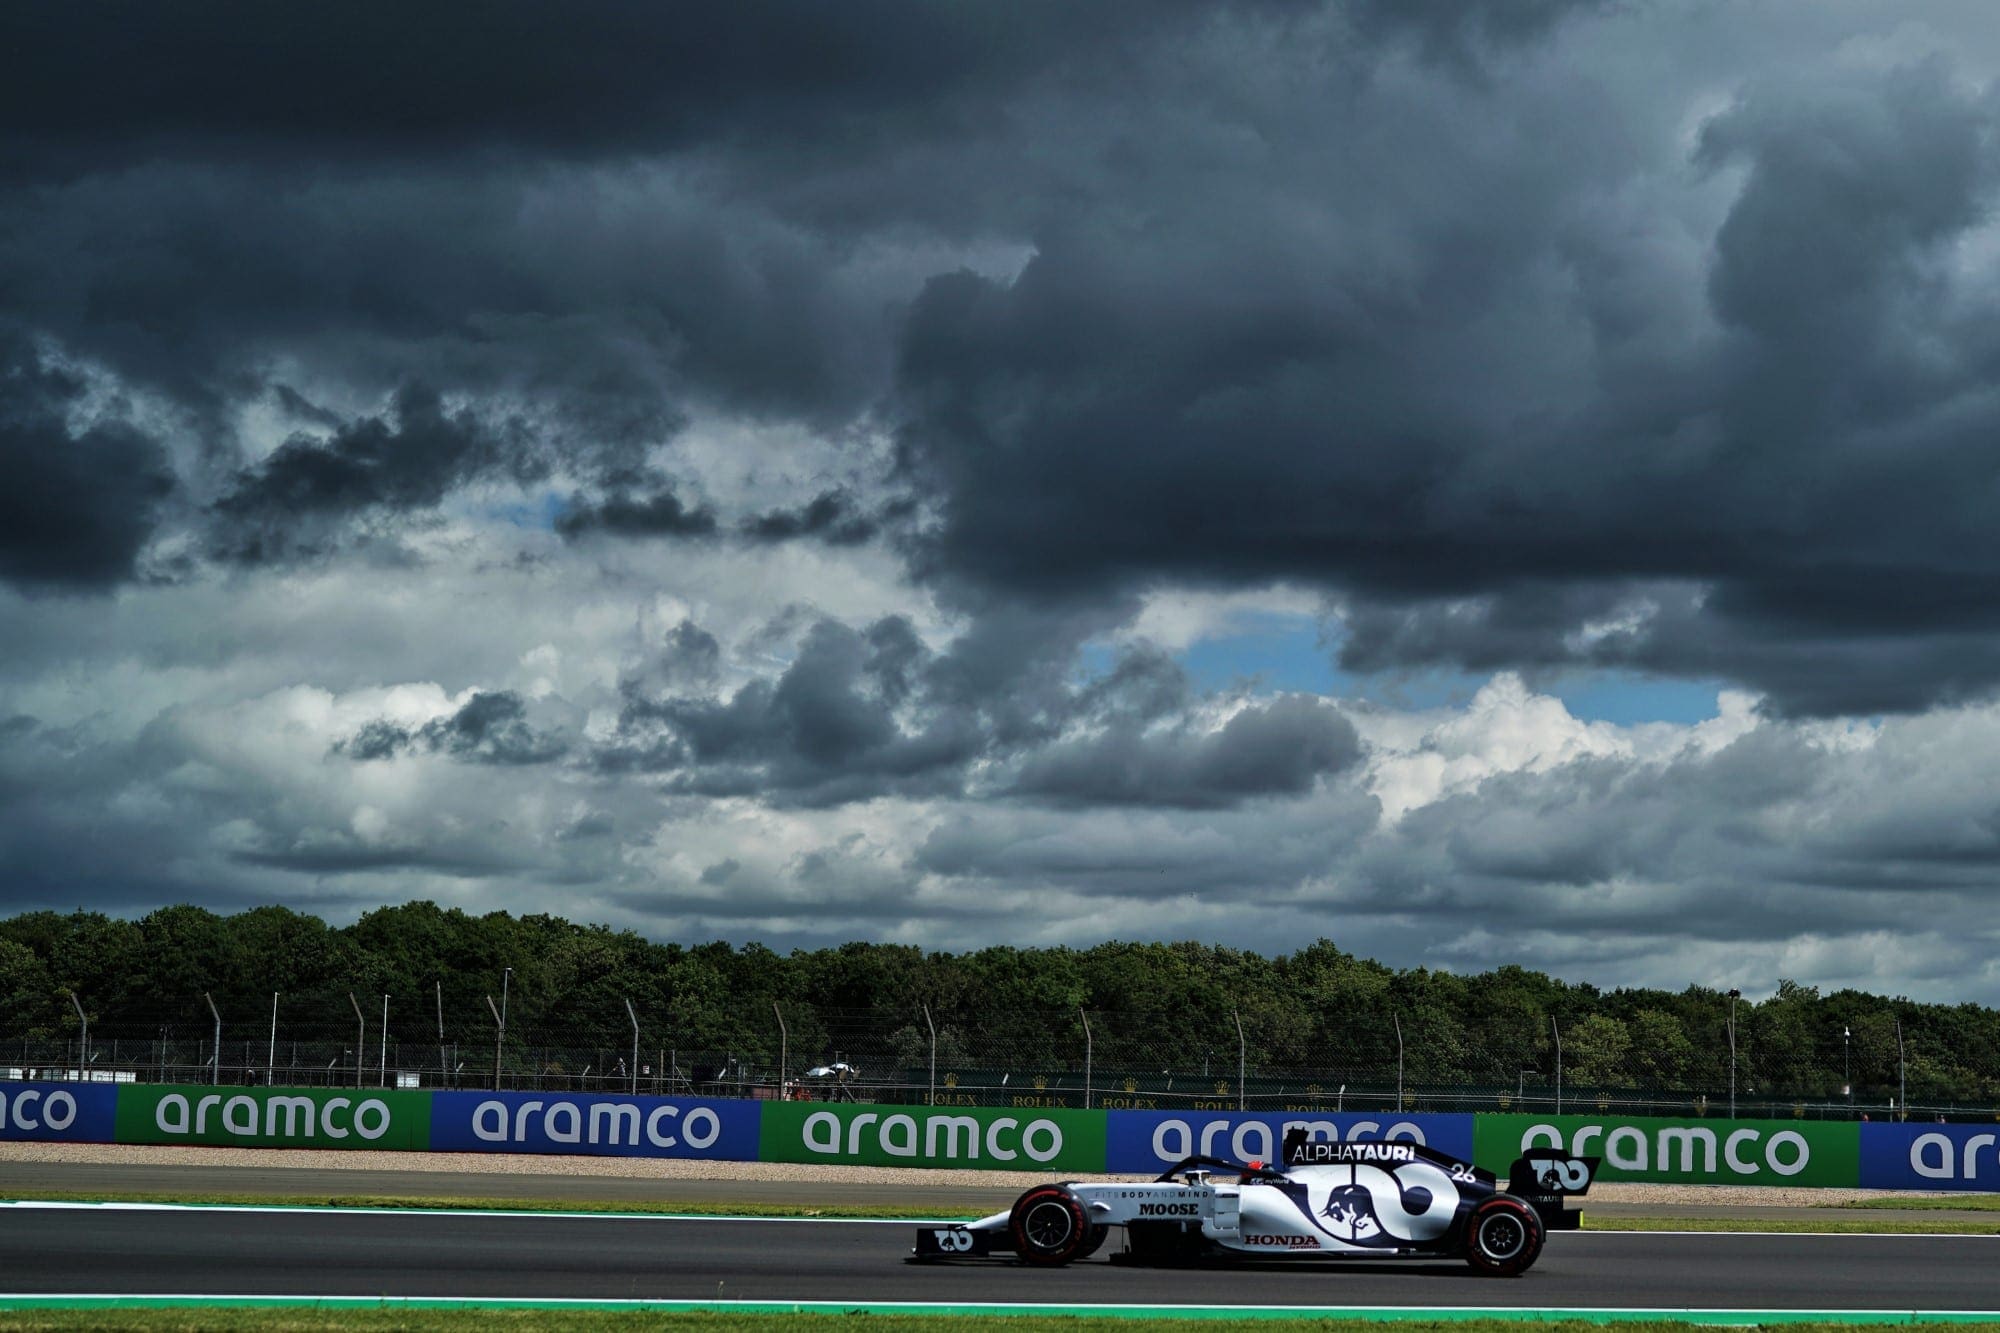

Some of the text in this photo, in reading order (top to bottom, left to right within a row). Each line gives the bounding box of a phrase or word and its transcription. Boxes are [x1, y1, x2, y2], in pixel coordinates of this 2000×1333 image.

[0, 1089, 77, 1130] co
[155, 1093, 391, 1140] aramco
[1012, 1095, 1067, 1108] ROLEX
[472, 1100, 720, 1151] aramco
[802, 1111, 1063, 1163] aramco
[1292, 1144, 1415, 1162] ALPHATAURI
[1520, 1124, 1810, 1175] aramco
[1910, 1132, 2000, 1179] ar
[1450, 1163, 1477, 1183] 26
[1139, 1203, 1199, 1216] MOOSE
[1244, 1234, 1321, 1246] HONDA
